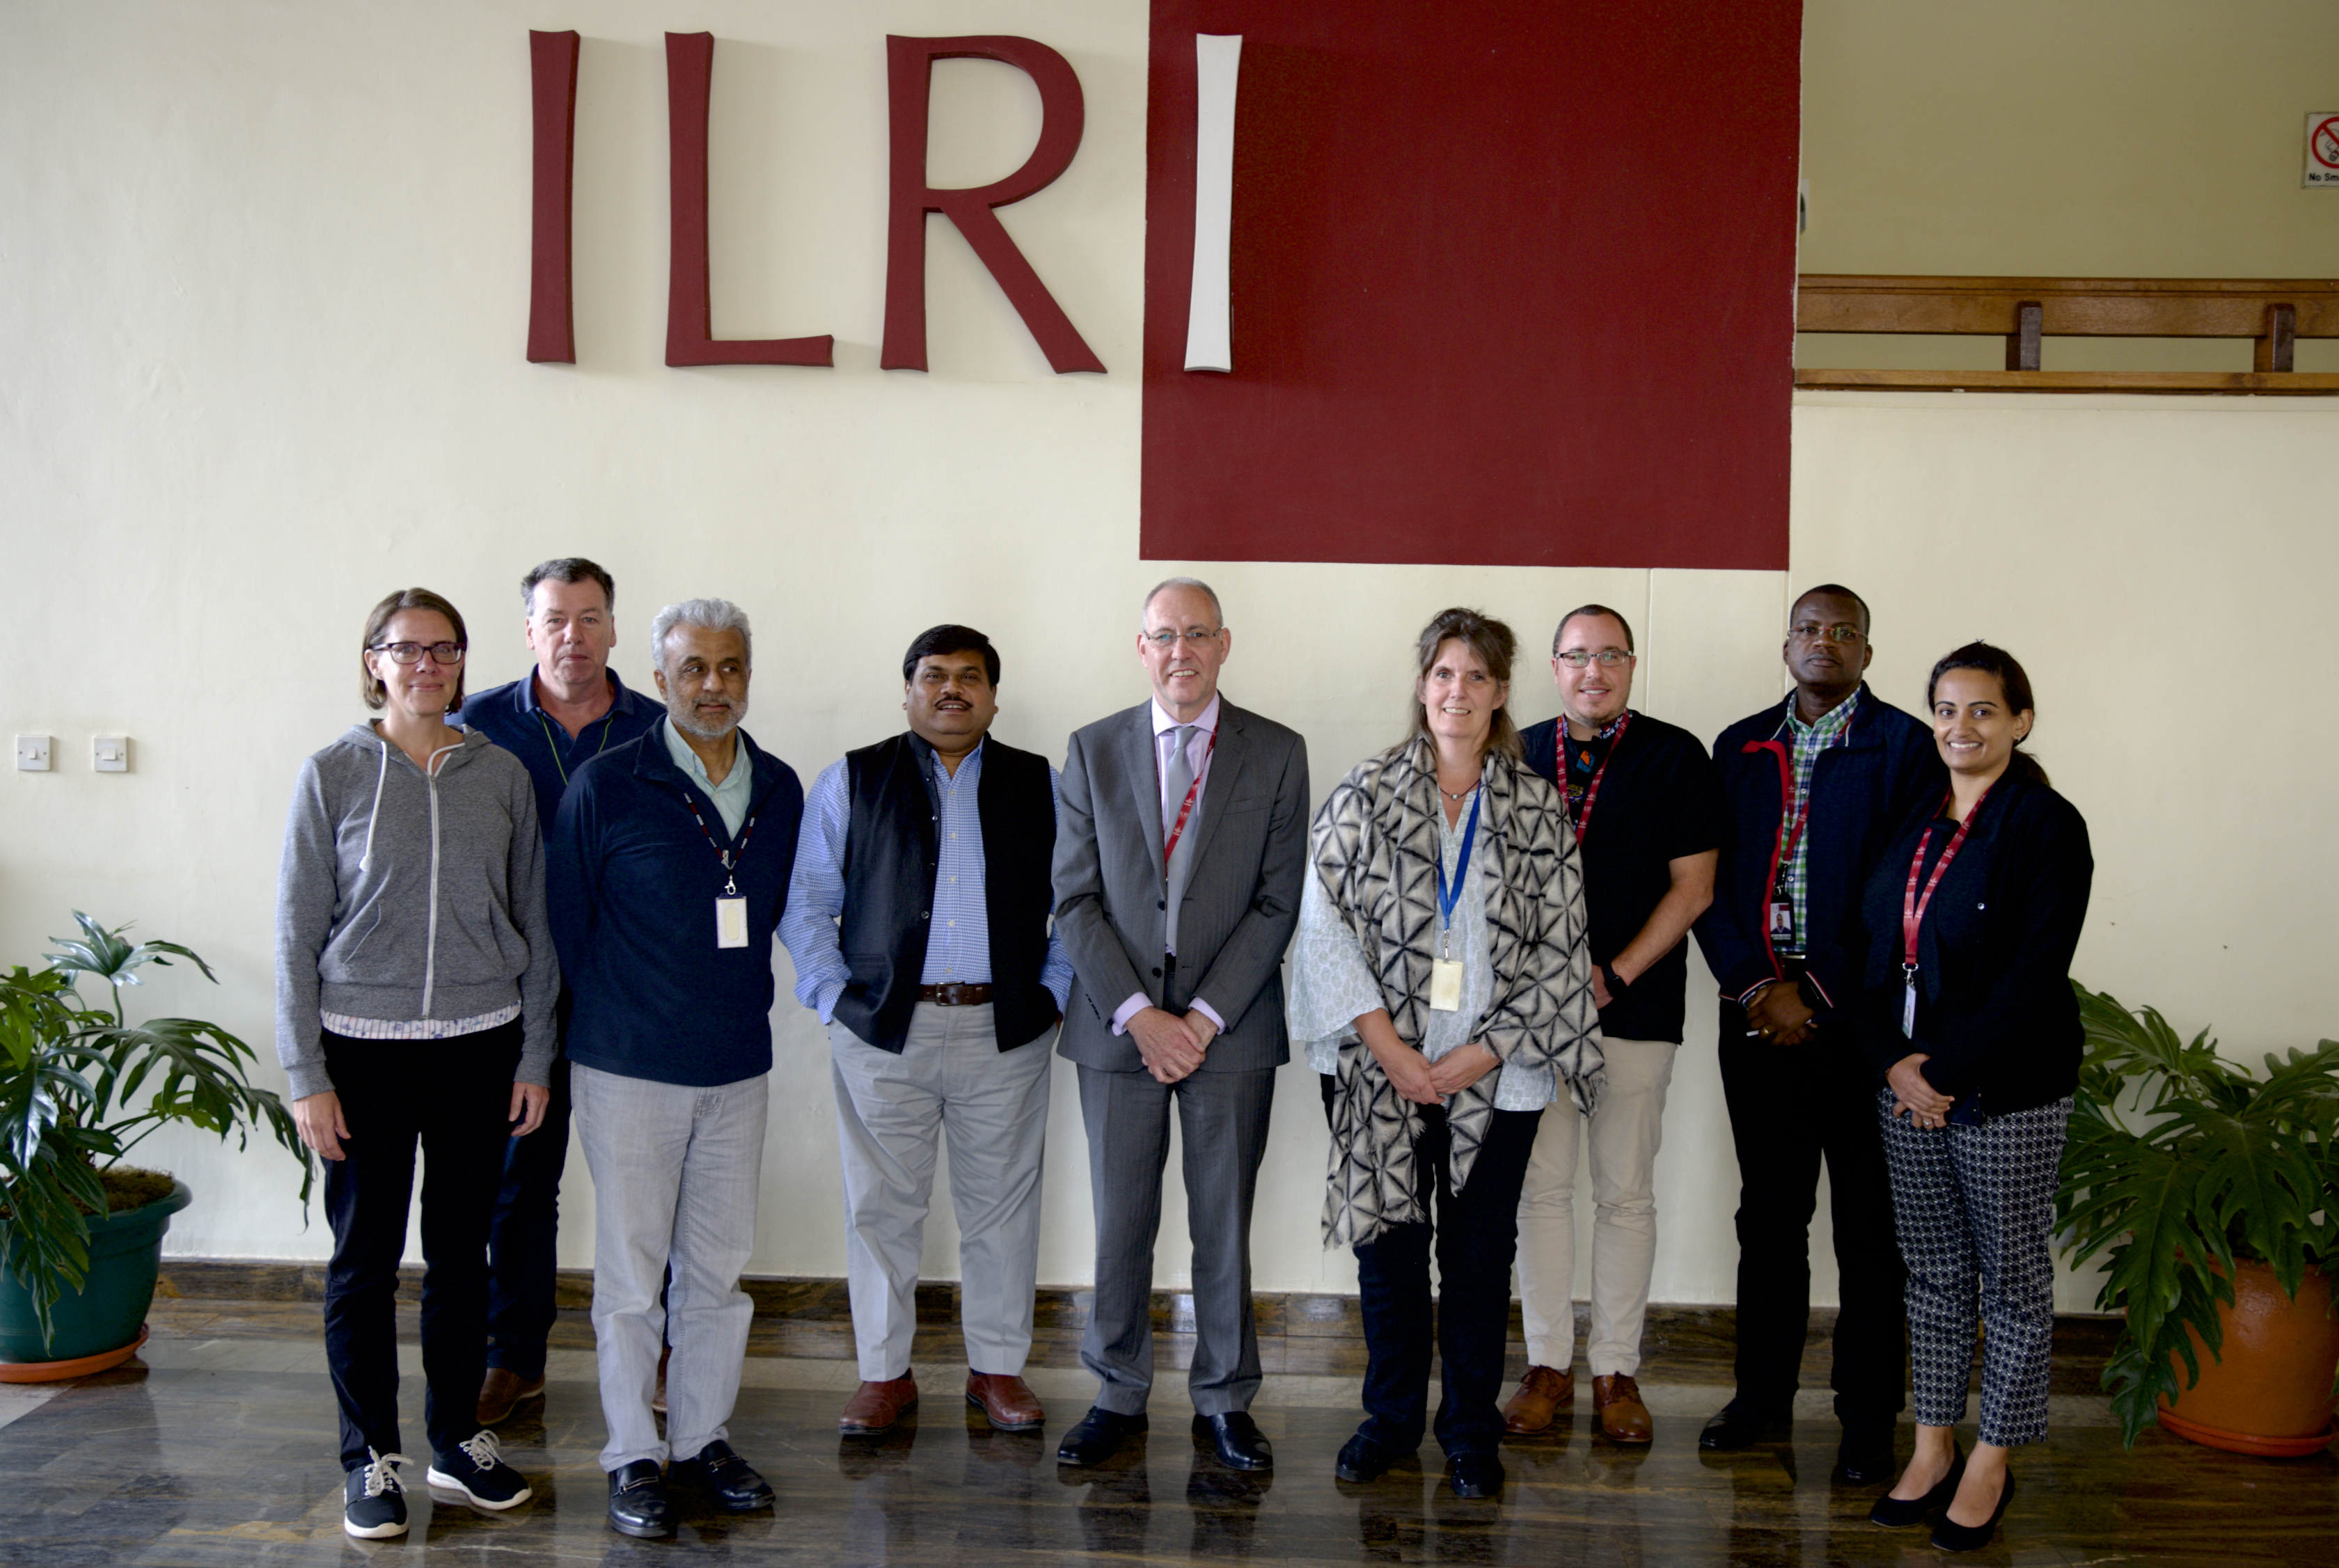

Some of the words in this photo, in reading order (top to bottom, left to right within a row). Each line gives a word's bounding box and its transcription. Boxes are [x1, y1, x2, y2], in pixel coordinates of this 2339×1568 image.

[526, 29, 1243, 374] ILRI
[2308, 173, 2321, 181] No
[2324, 173, 2339, 181] Sm
